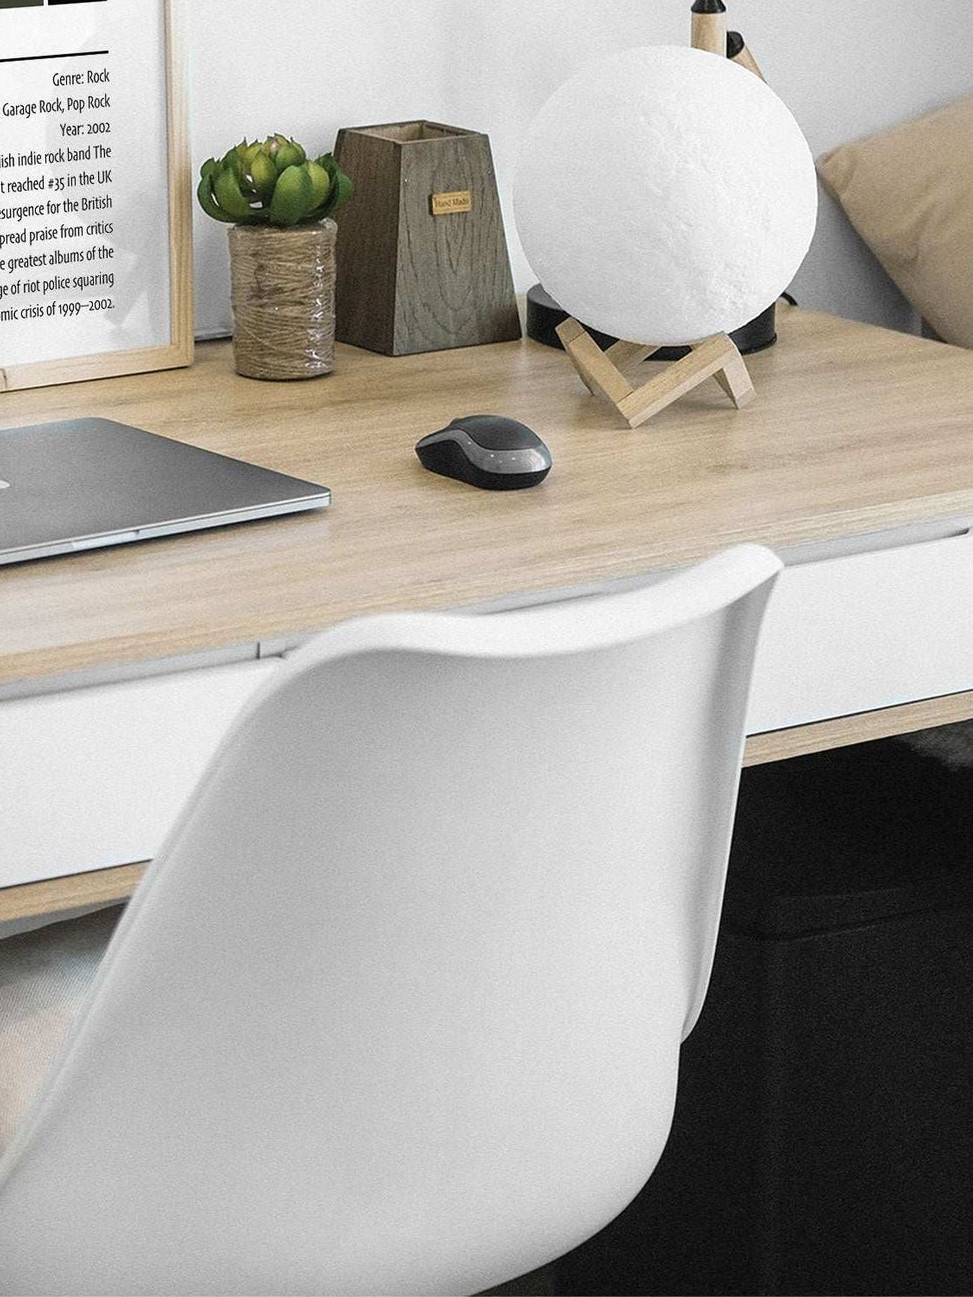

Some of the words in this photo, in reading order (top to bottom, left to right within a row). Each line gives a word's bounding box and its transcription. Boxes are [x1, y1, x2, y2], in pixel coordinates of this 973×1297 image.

[52, 73, 84, 86] Genre:
[87, 68, 110, 83] Rock
[2, 103, 37, 119] Garage
[39, 97, 65, 114] Rock,
[67, 97, 85, 114] Pop
[88, 93, 110, 109] Rock
[60, 123, 84, 136] Year:
[87, 122, 111, 134] 2002
[18, 151, 42, 166] indie
[44, 148, 65, 164] rock
[67, 145, 91, 162] band
[93, 144, 112, 159] The
[7, 175, 44, 193] reached
[48, 177, 65, 191] #35
[67, 173, 76, 187] in
[79, 171, 95, 186] the
[97, 170, 112, 184] UK
[46, 200, 61, 214] for
[63, 198, 79, 213] the
[81, 194, 112, 211] British
[29, 226, 58, 246] praise
[60, 224, 83, 238] from
[86, 221, 114, 235] critics
[8, 254, 47, 274] greatest
[48, 250, 84, 265] albums
[86, 246, 96, 261] of
[98, 245, 114, 259] the
[10, 280, 21, 295] of
[23, 279, 40, 293] riot
[43, 276, 70, 295] police
[73, 271, 114, 291] squaring
[20, 304, 44, 319] crisis
[46, 301, 56, 316] of
